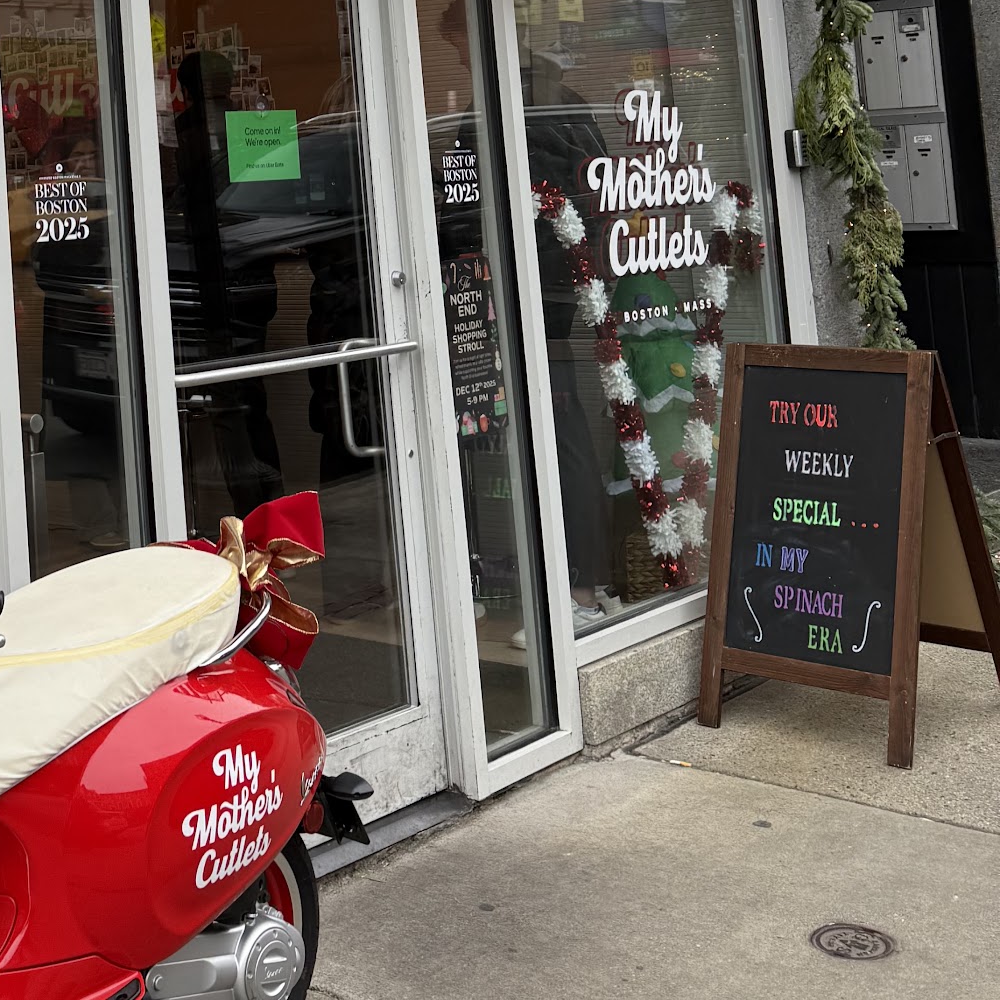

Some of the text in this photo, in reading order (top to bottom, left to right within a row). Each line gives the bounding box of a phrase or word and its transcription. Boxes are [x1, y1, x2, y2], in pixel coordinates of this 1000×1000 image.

[244, 127, 264, 136] Come
[265, 127, 274, 136] on
[624, 90, 684, 163] My
[443, 154, 476, 168] BEST OF
[443, 168, 478, 182] BOSTON
[587, 143, 716, 212] Mother's
[35, 181, 87, 198] BEST OF
[444, 183, 480, 203] 2025
[35, 198, 88, 215] BOSTON
[35, 216, 90, 243] 2025
[609, 215, 709, 277] Cutlets
[449, 290, 483, 306] NORTH
[458, 304, 478, 317] END
[624, 299, 712, 323] BOSTON MASS
[452, 329, 487, 344] SHOPPING
[454, 319, 483, 333] HOLIDAY
[457, 341, 485, 354] STROLL
[455, 384, 471, 396] DEC
[483, 380, 497, 389] 2025
[466, 393, 489, 406] 5-9 PM
[769, 400, 838, 428] TRY OUR
[785, 449, 854, 478] WEEKLY
[772, 496, 842, 527] SPECIAL
[755, 542, 809, 573] IN MY
[774, 584, 844, 619] SPINACH
[808, 624, 843, 654] ERA
[212, 744, 261, 794] My
[182, 769, 283, 850] Mother's
[195, 825, 272, 889] Cutlets
